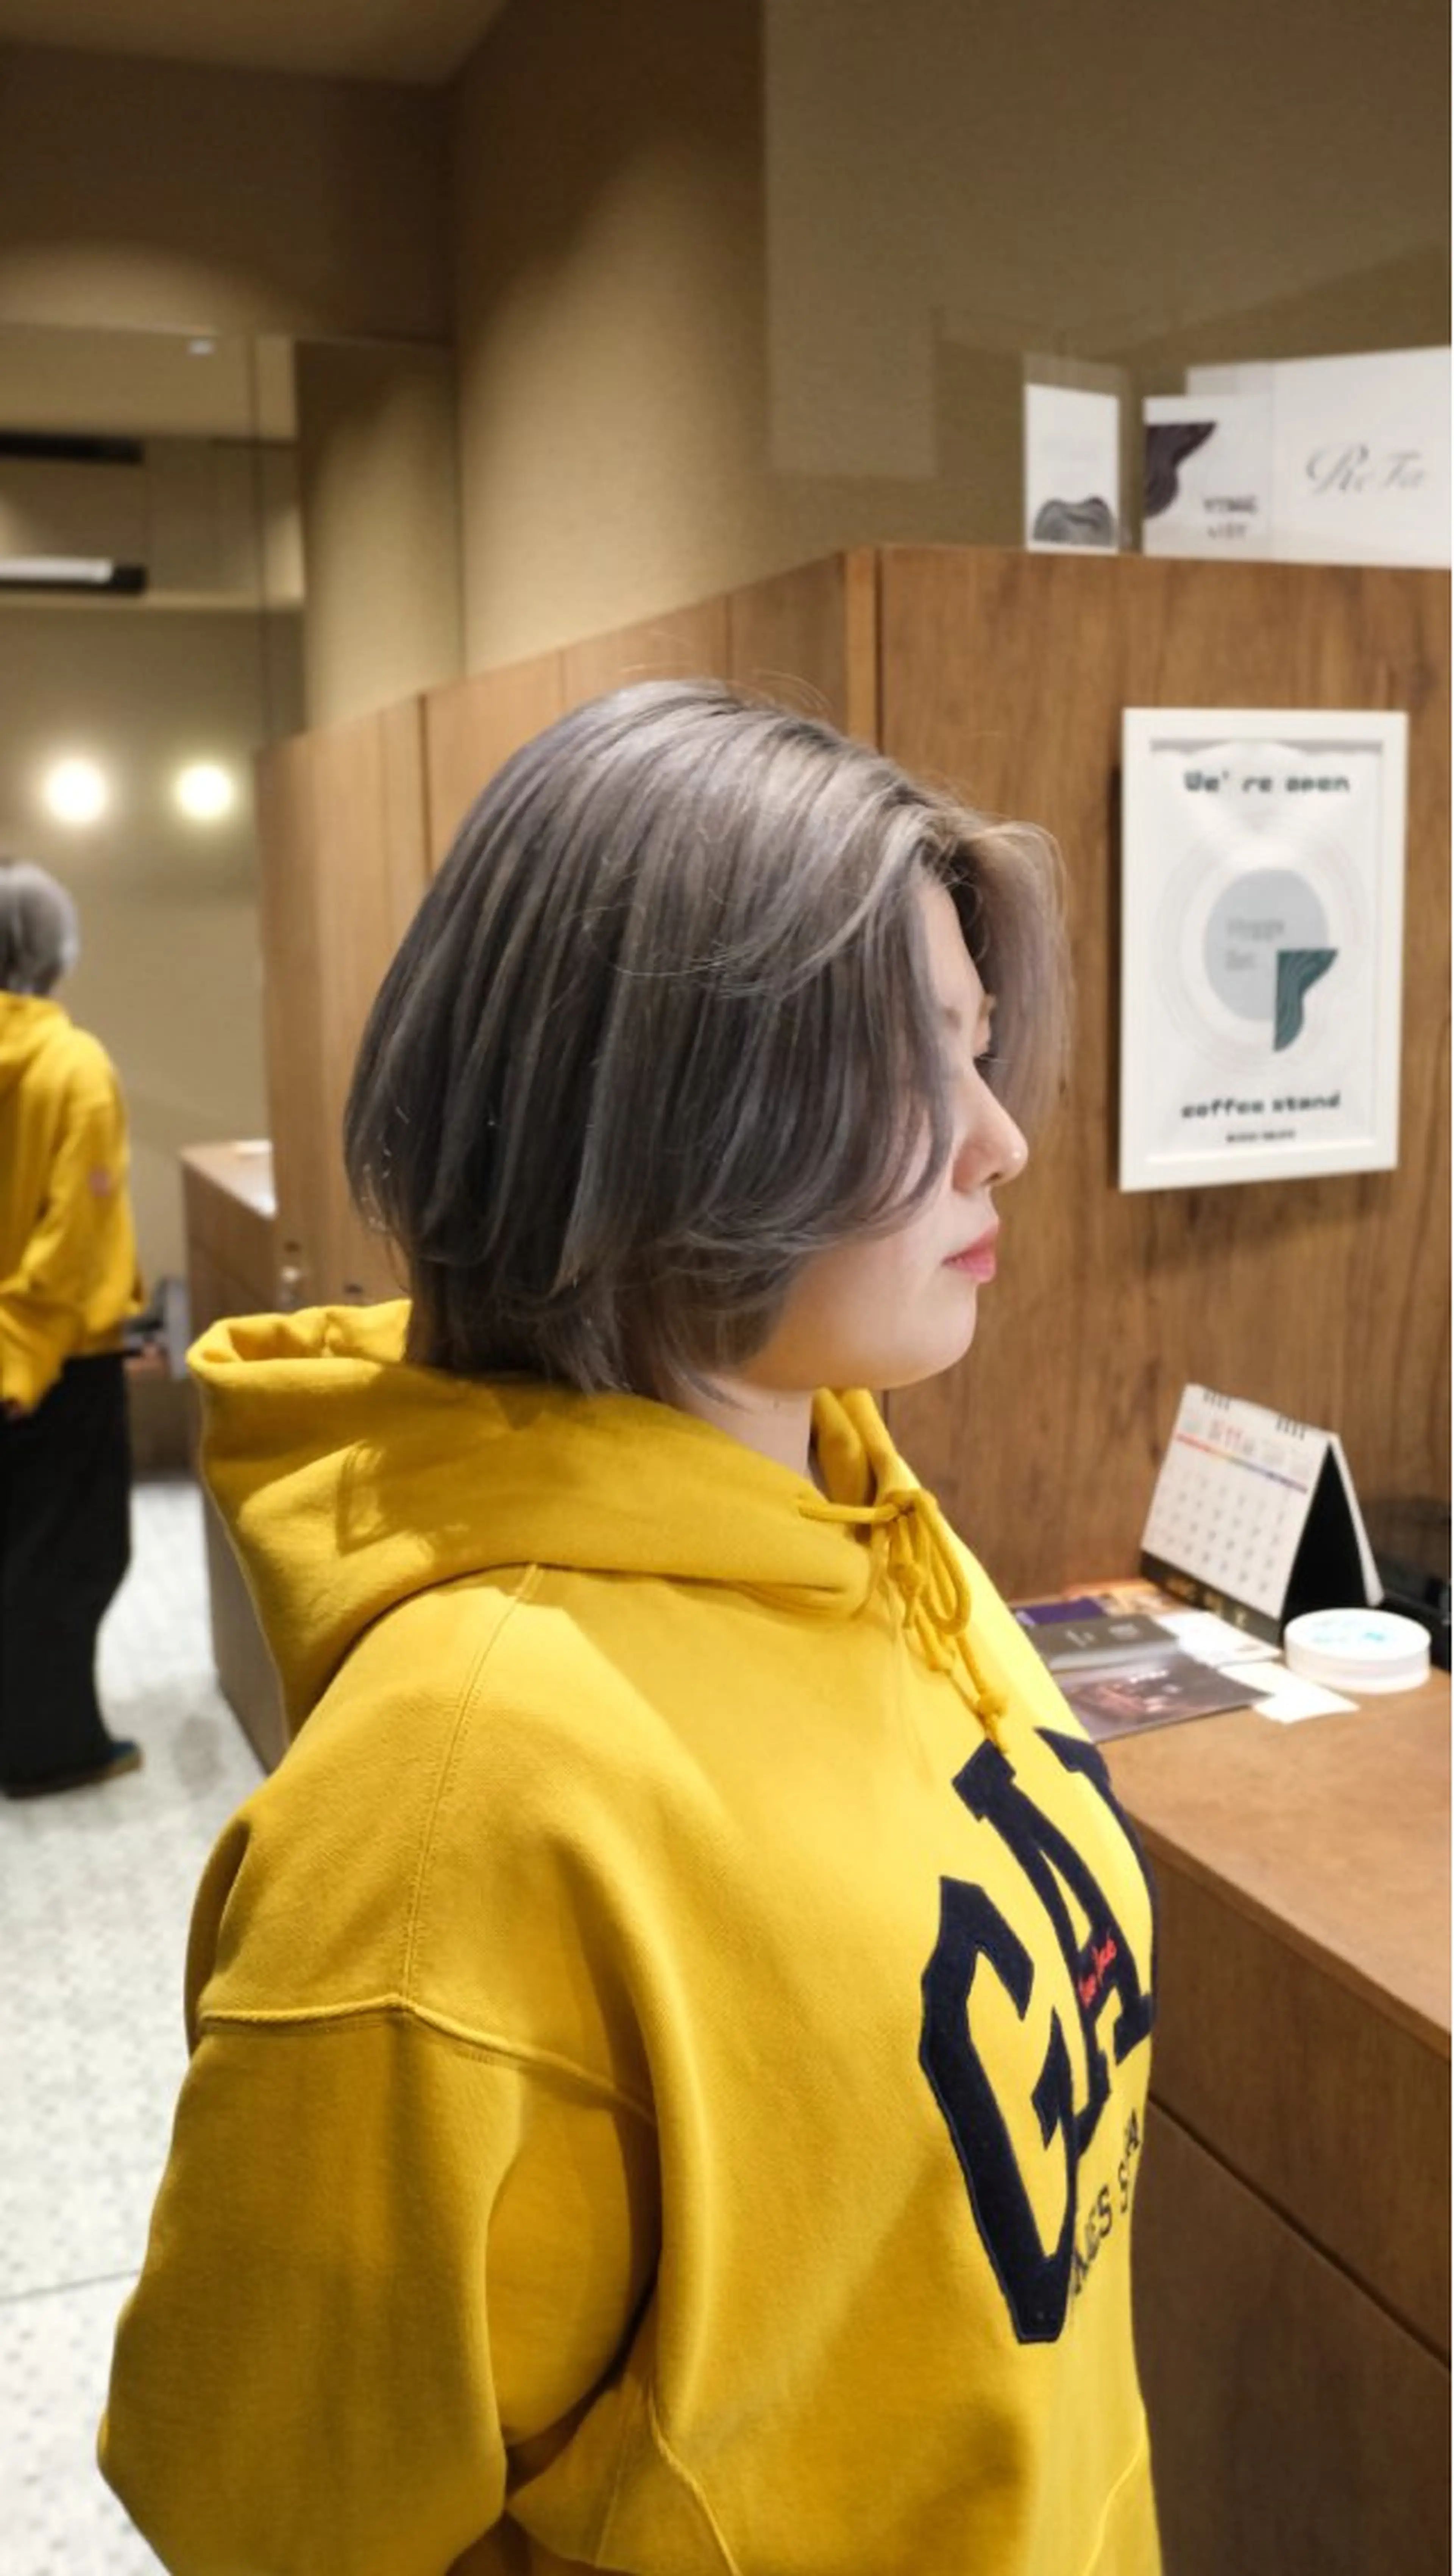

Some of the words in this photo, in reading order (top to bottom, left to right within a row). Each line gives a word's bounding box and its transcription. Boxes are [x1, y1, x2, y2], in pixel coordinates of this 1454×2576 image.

[1285, 776, 1350, 792] open
[1181, 1098, 1264, 1118] coffee
[1272, 1092, 1341, 1112] stand
